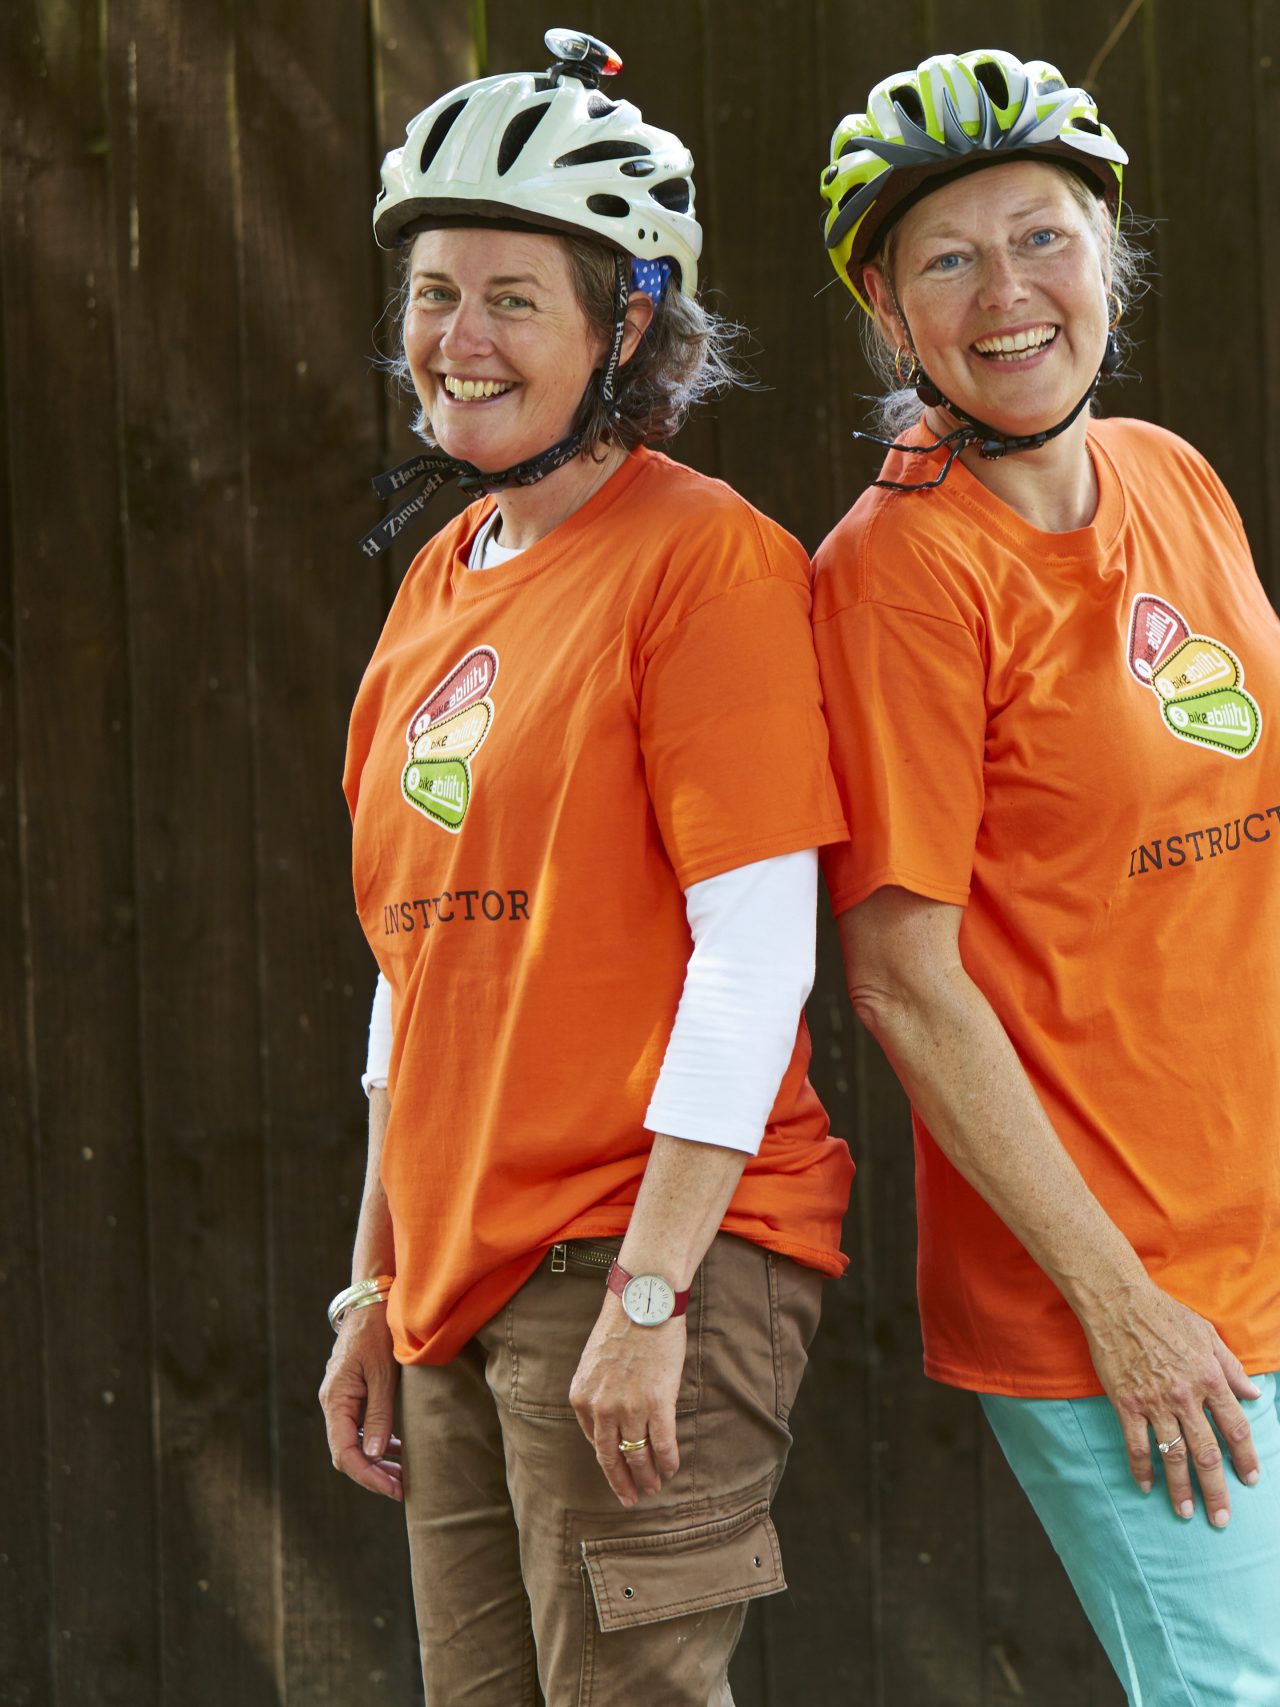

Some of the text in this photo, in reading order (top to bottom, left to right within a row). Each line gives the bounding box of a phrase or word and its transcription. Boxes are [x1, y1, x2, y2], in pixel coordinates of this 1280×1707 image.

[603, 321, 624, 400] HardnutZ
[362, 473, 444, 557] HardnutZ H
[431, 660, 488, 722] bikeability
[1172, 648, 1229, 689] bikeability
[1188, 702, 1250, 735] bikeability
[419, 775, 464, 810] bikeability
